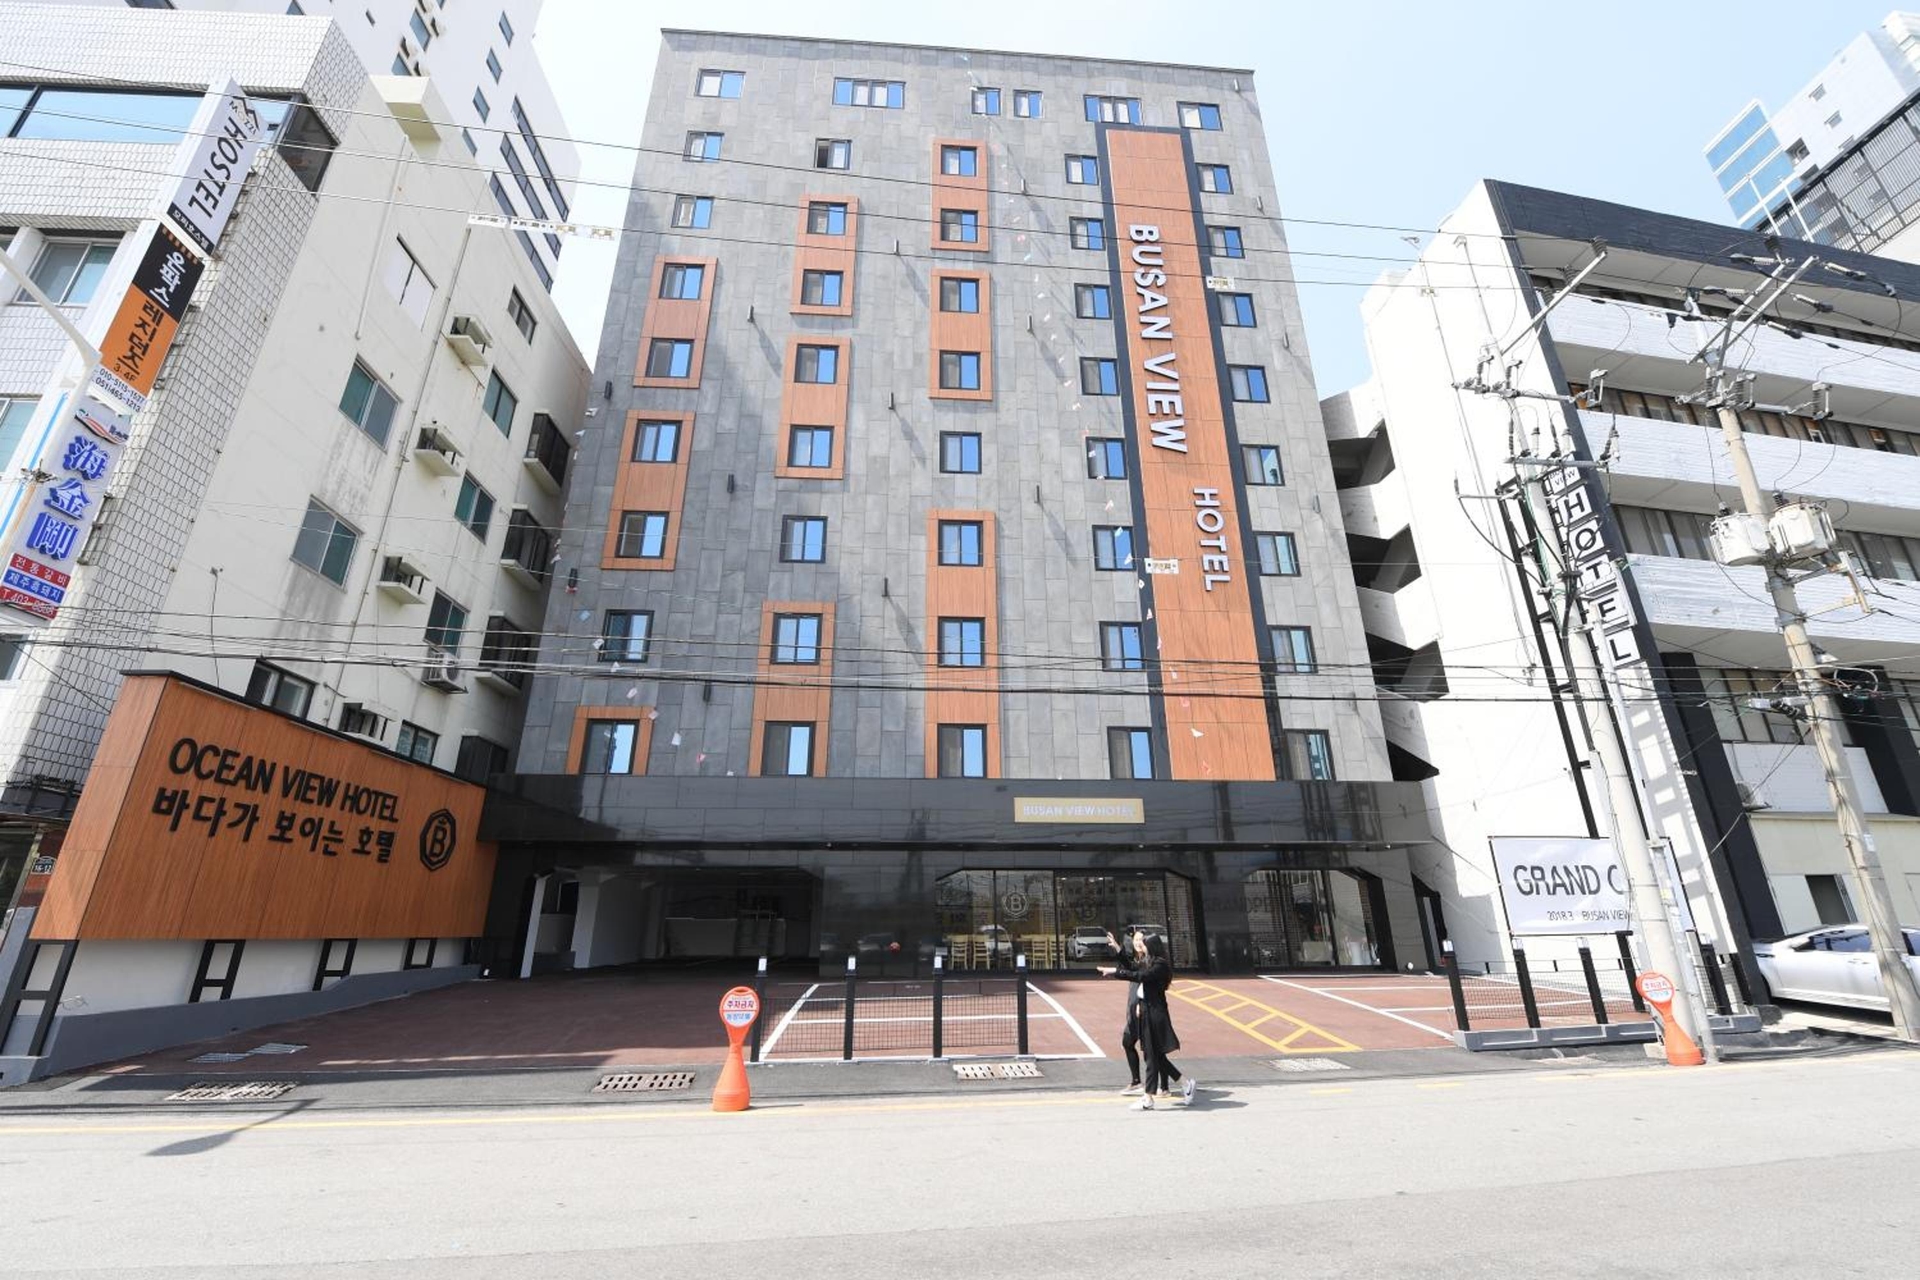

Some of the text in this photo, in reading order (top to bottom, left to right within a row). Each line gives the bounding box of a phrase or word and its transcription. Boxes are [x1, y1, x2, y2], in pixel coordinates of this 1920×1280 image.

[188, 116, 248, 219] HOSTEL
[1129, 223, 1188, 454] BUSAN VIEW
[1193, 487, 1231, 592] HOTEL
[1564, 492, 1632, 662] HOTEL
[169, 738, 399, 823] OCEAN VIEW HOTEL
[1023, 805, 1136, 818] BUSAN VIEW HOTEL
[152, 786, 396, 863] 바다가 보이는 호텔
[1513, 864, 1601, 896] GRAND
[1581, 909, 1610, 921] BUSAN
